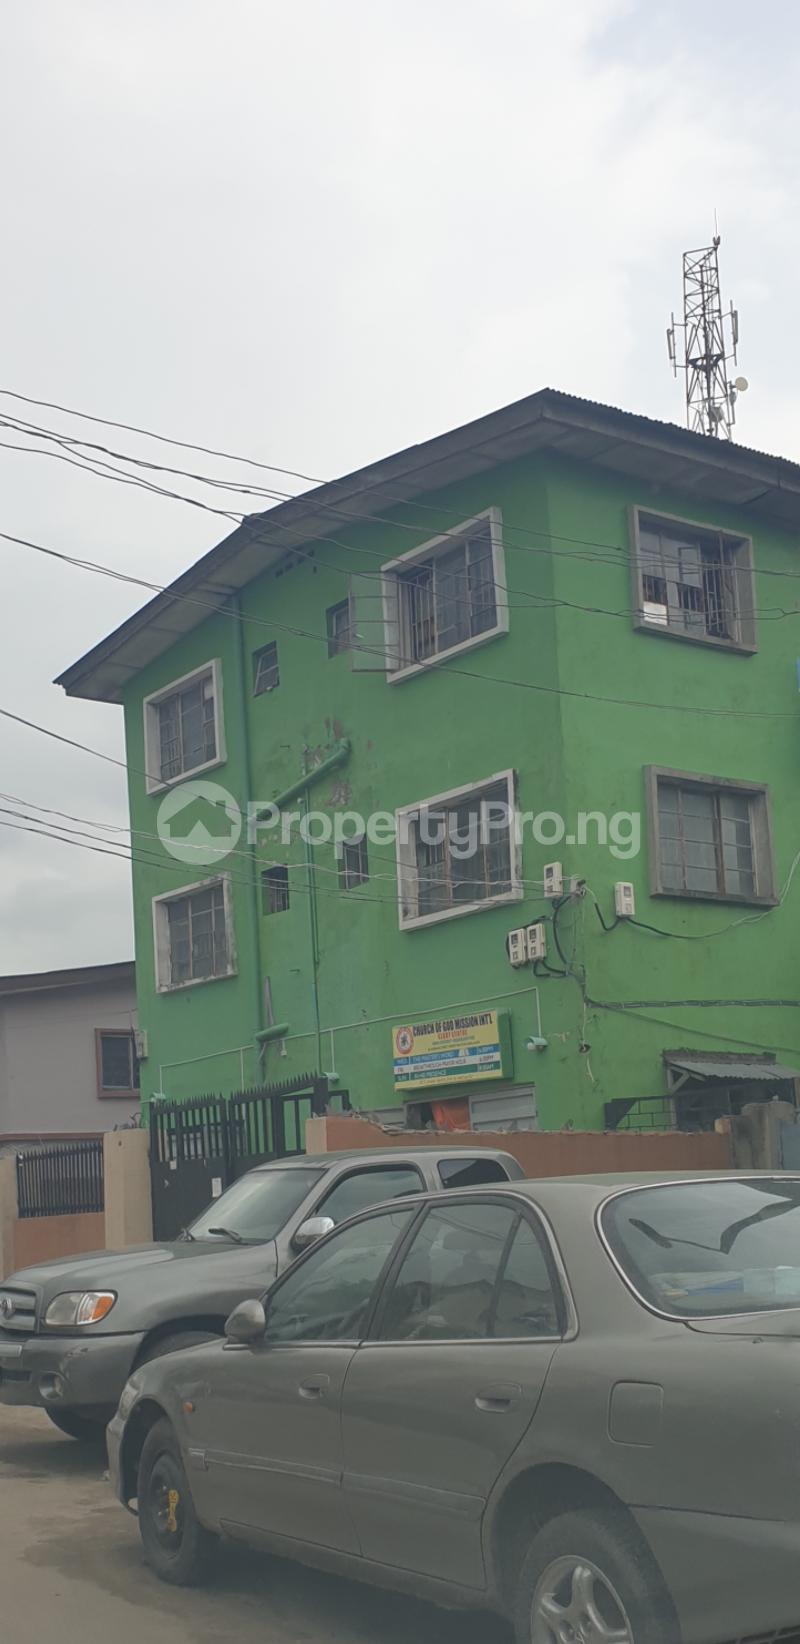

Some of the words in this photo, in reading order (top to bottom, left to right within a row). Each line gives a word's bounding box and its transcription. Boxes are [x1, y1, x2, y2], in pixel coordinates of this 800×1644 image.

[413, 1024, 435, 1037] CHURCH
[436, 1022, 442, 1032] OF
[443, 1020, 454, 1031] GOD
[455, 1016, 478, 1029] MISSION
[479, 1013, 493, 1026] INT'L
